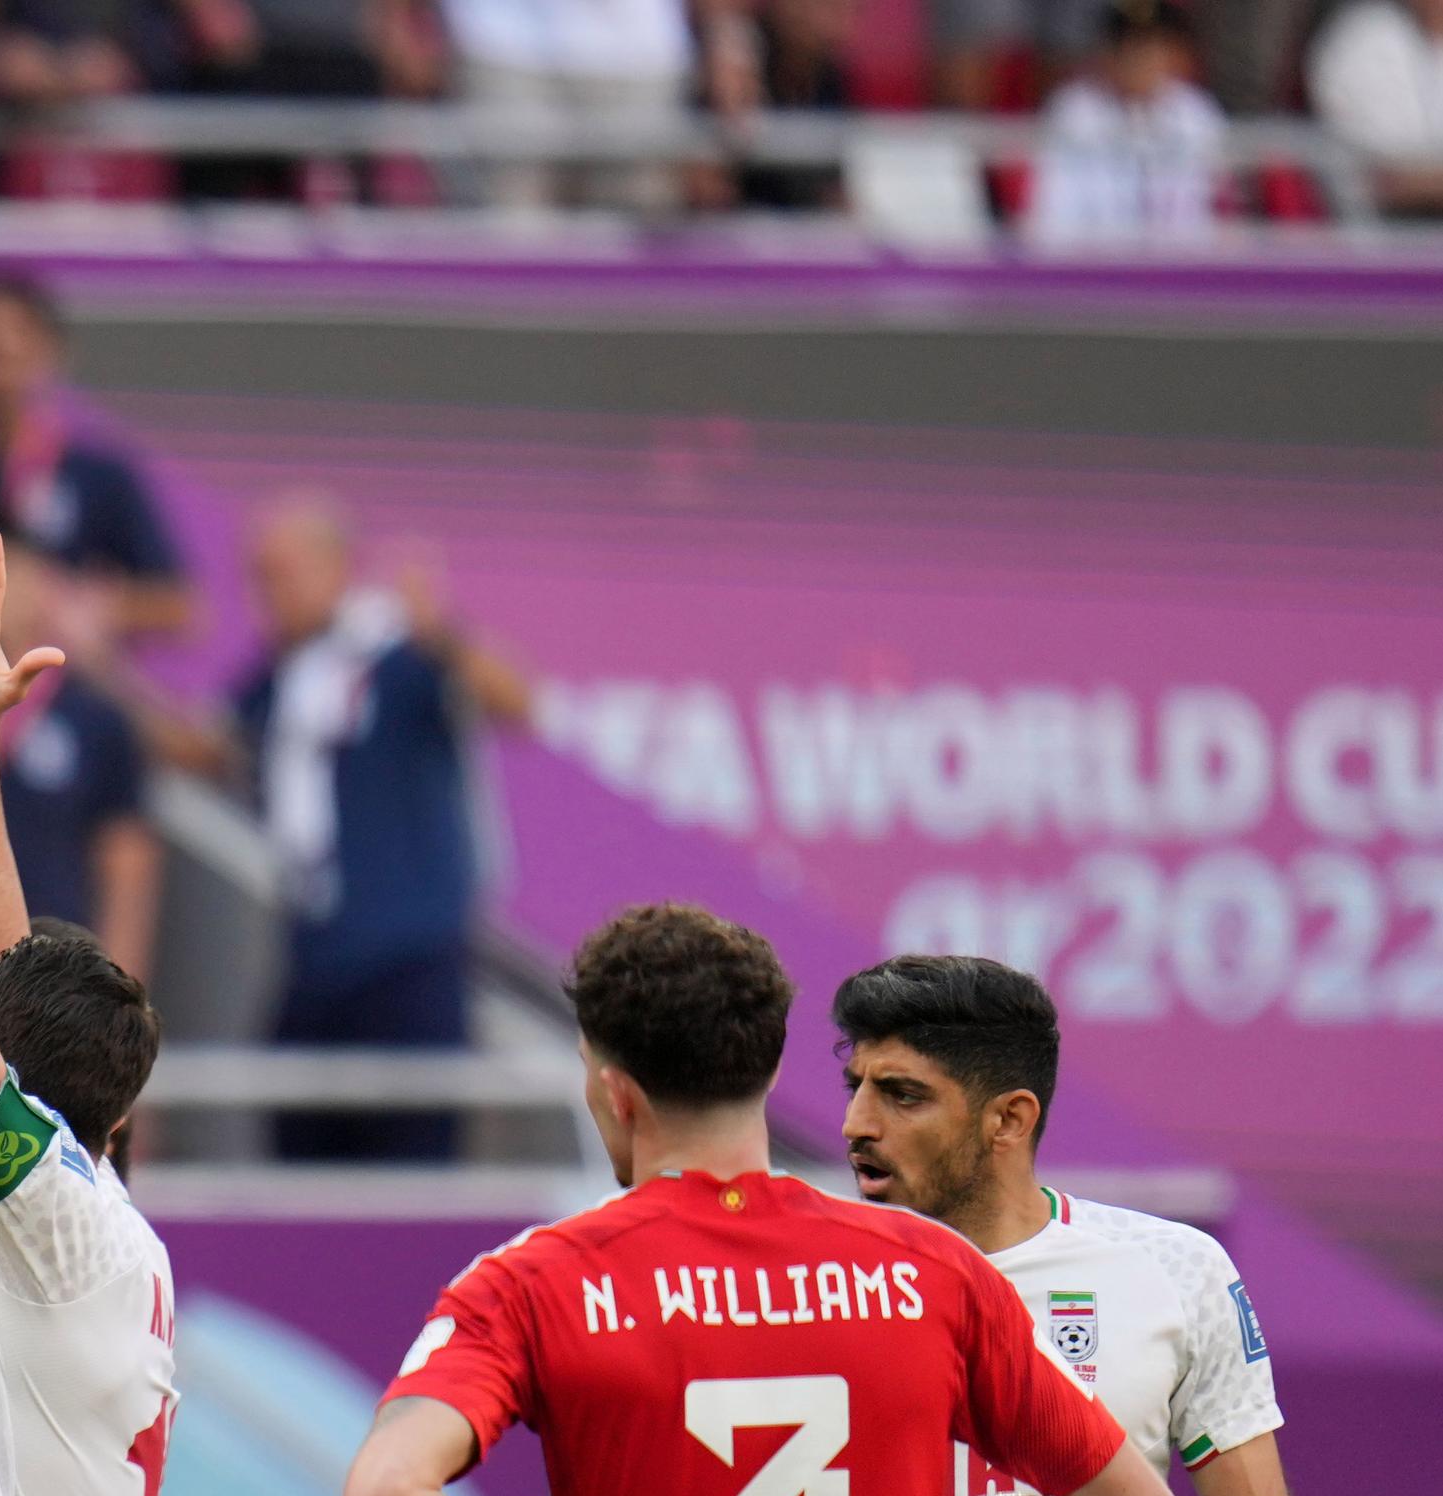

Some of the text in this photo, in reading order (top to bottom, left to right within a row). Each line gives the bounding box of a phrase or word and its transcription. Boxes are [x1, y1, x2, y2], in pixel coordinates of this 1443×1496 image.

[754, 680, 1270, 838] WORLD
[583, 1262, 924, 1333] N. WILLIAMS
